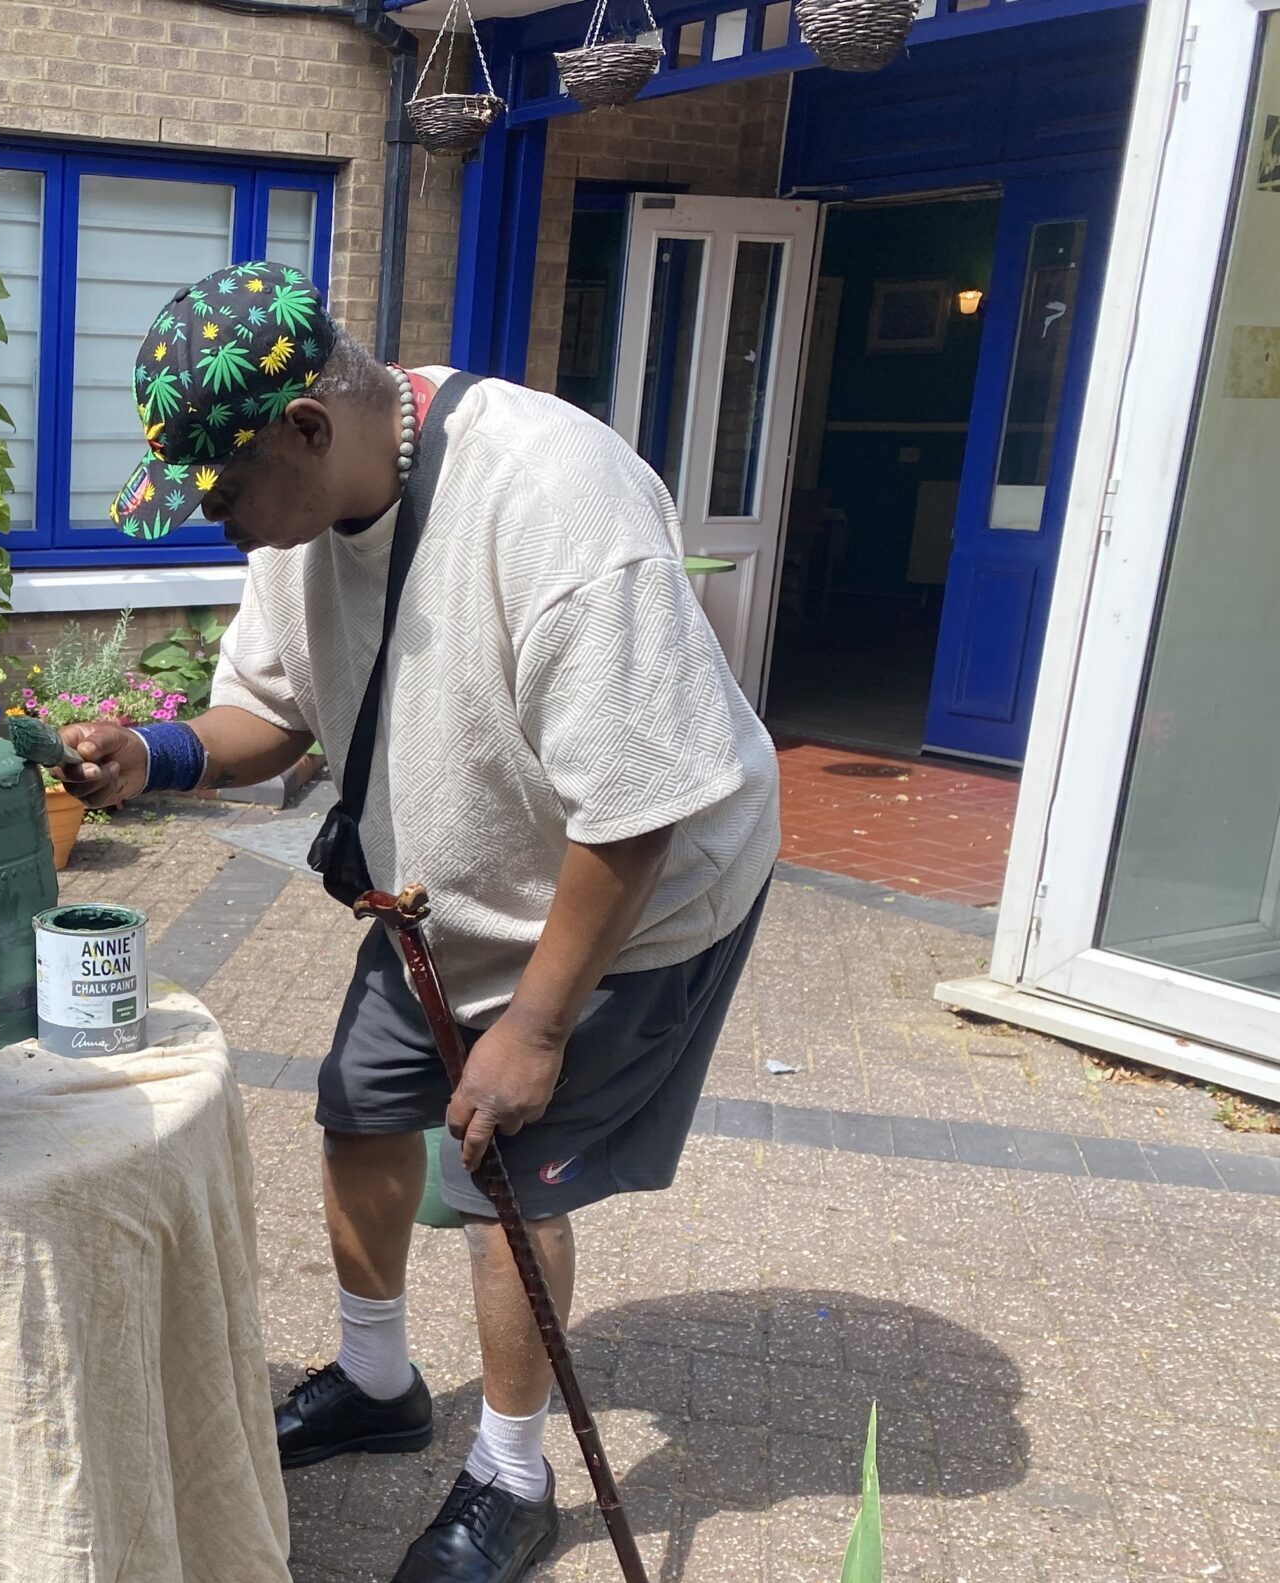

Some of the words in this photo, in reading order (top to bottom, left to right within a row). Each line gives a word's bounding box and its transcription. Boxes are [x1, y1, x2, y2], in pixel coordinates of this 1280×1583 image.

[81, 936, 131, 957] ANNIE
[81, 955, 131, 977] SLOAN
[75, 983, 108, 994] CHALK
[110, 978, 136, 993] PAINT
